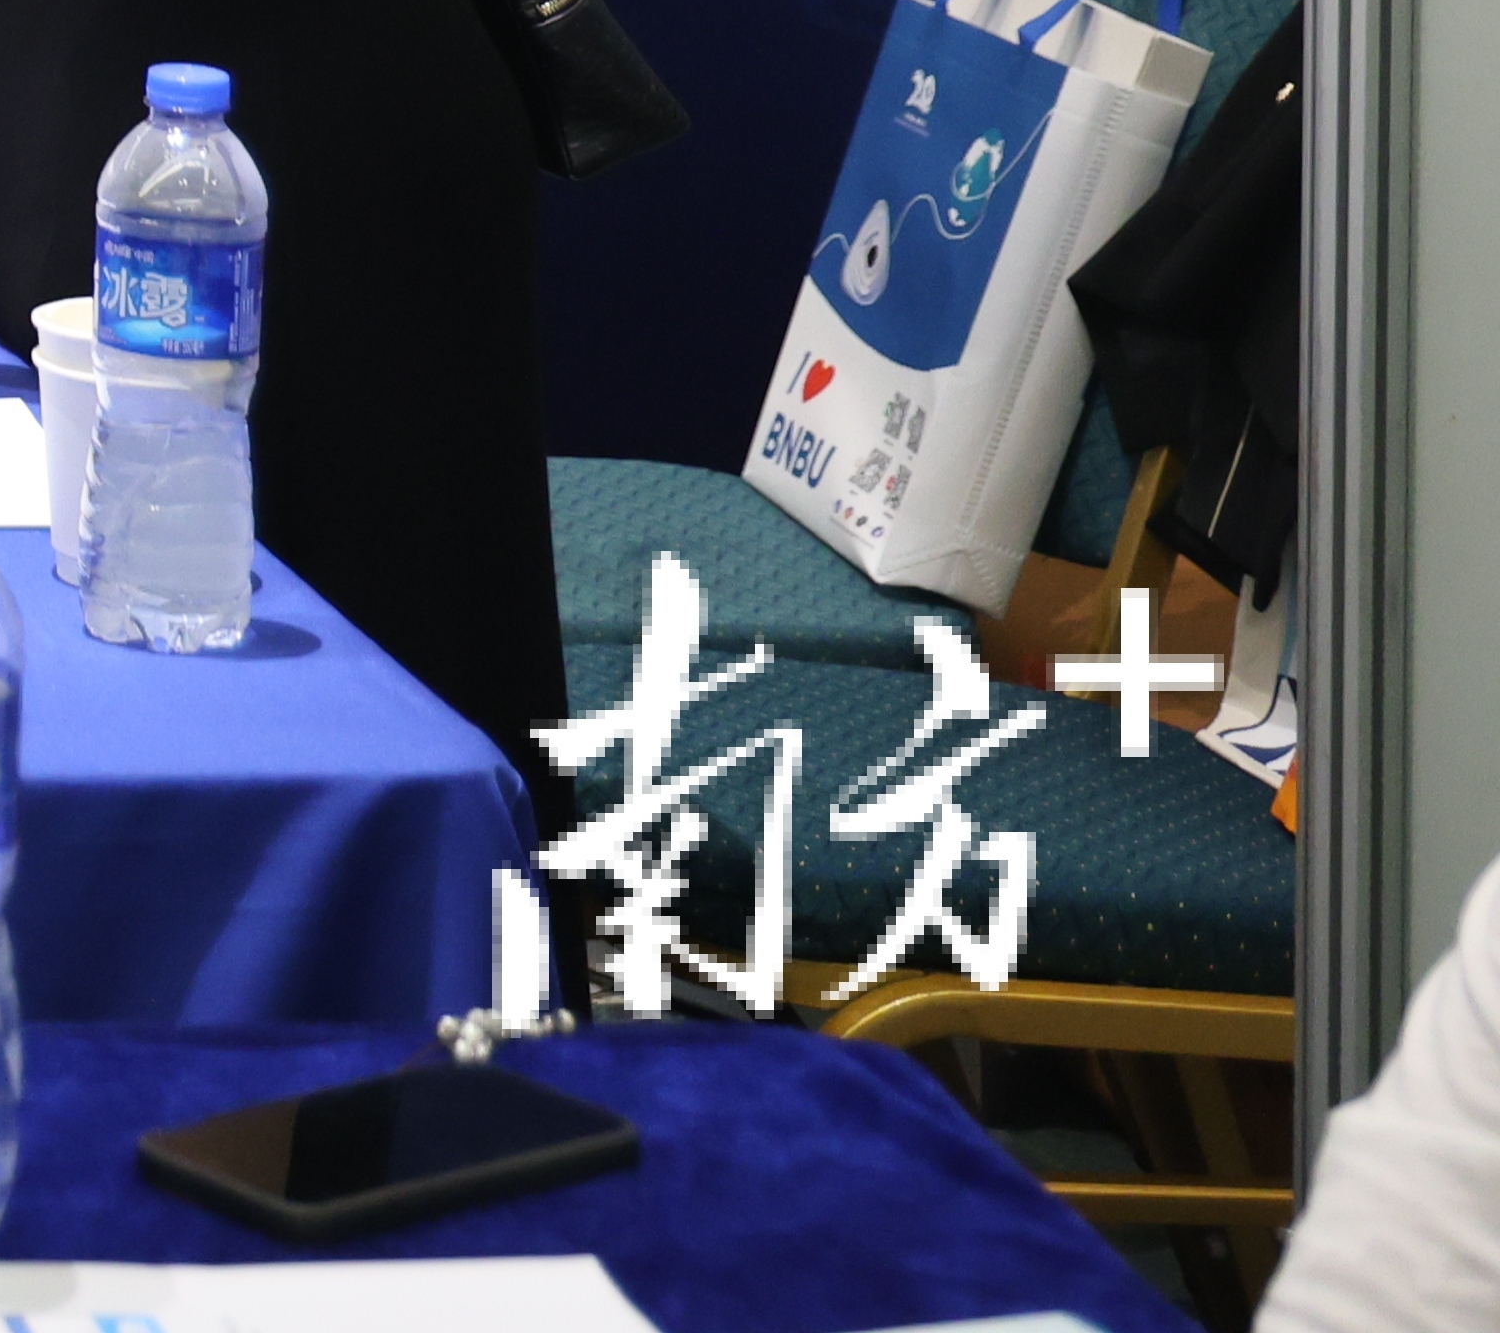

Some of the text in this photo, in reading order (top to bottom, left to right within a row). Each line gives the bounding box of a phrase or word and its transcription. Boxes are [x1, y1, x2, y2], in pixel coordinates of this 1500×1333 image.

[101, 266, 190, 329] 冰露
[787, 350, 812, 395] I
[762, 411, 838, 490] BNBU
